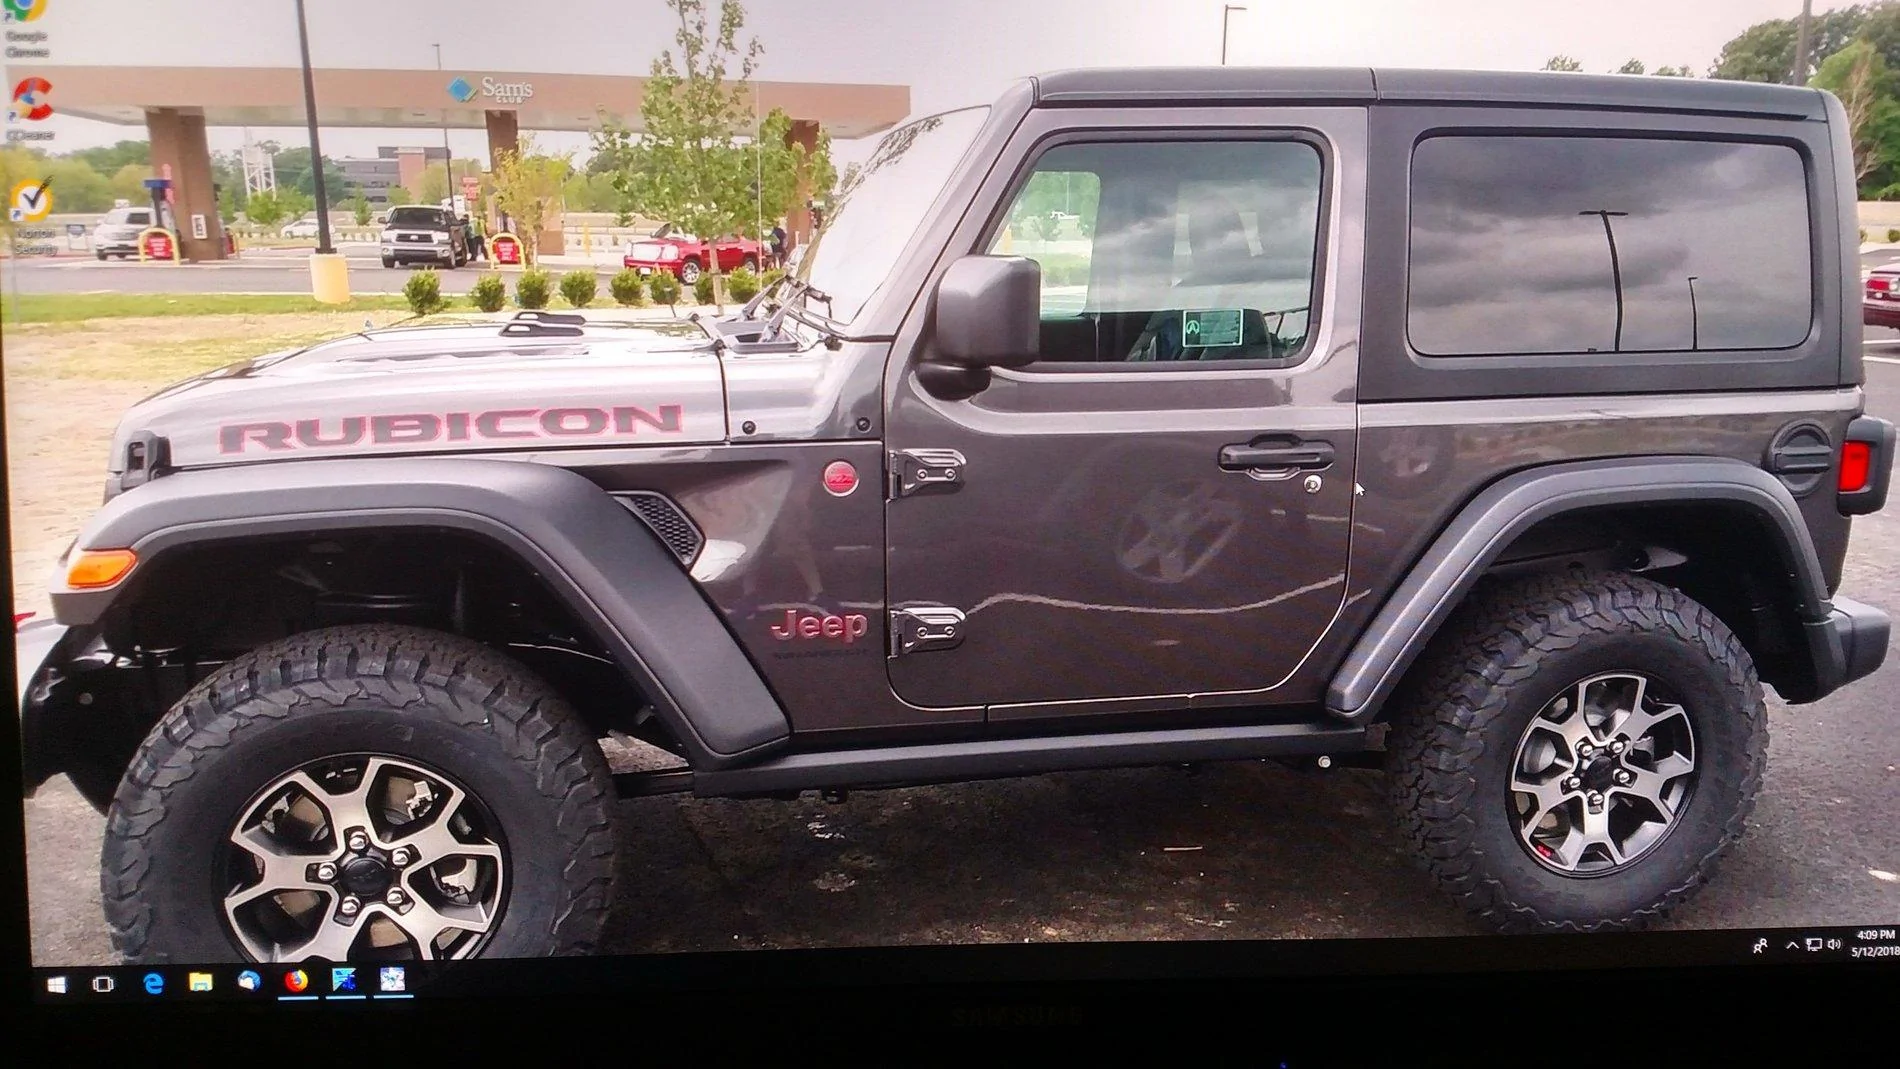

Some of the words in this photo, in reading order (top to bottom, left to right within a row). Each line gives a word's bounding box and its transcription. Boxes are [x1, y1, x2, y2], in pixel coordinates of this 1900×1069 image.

[5, 31, 48, 44] Google
[482, 76, 534, 97] Sam's
[496, 96, 524, 104] CLUB
[6, 130, 55, 141] CCleaner
[18, 229, 55, 238] Norton
[219, 404, 685, 454] RUBICON
[771, 609, 868, 643] Jeep
[1857, 930, 1878, 940] 4:09
[1880, 929, 1896, 939] PM
[1851, 946, 1900, 958] 5/12/2018
